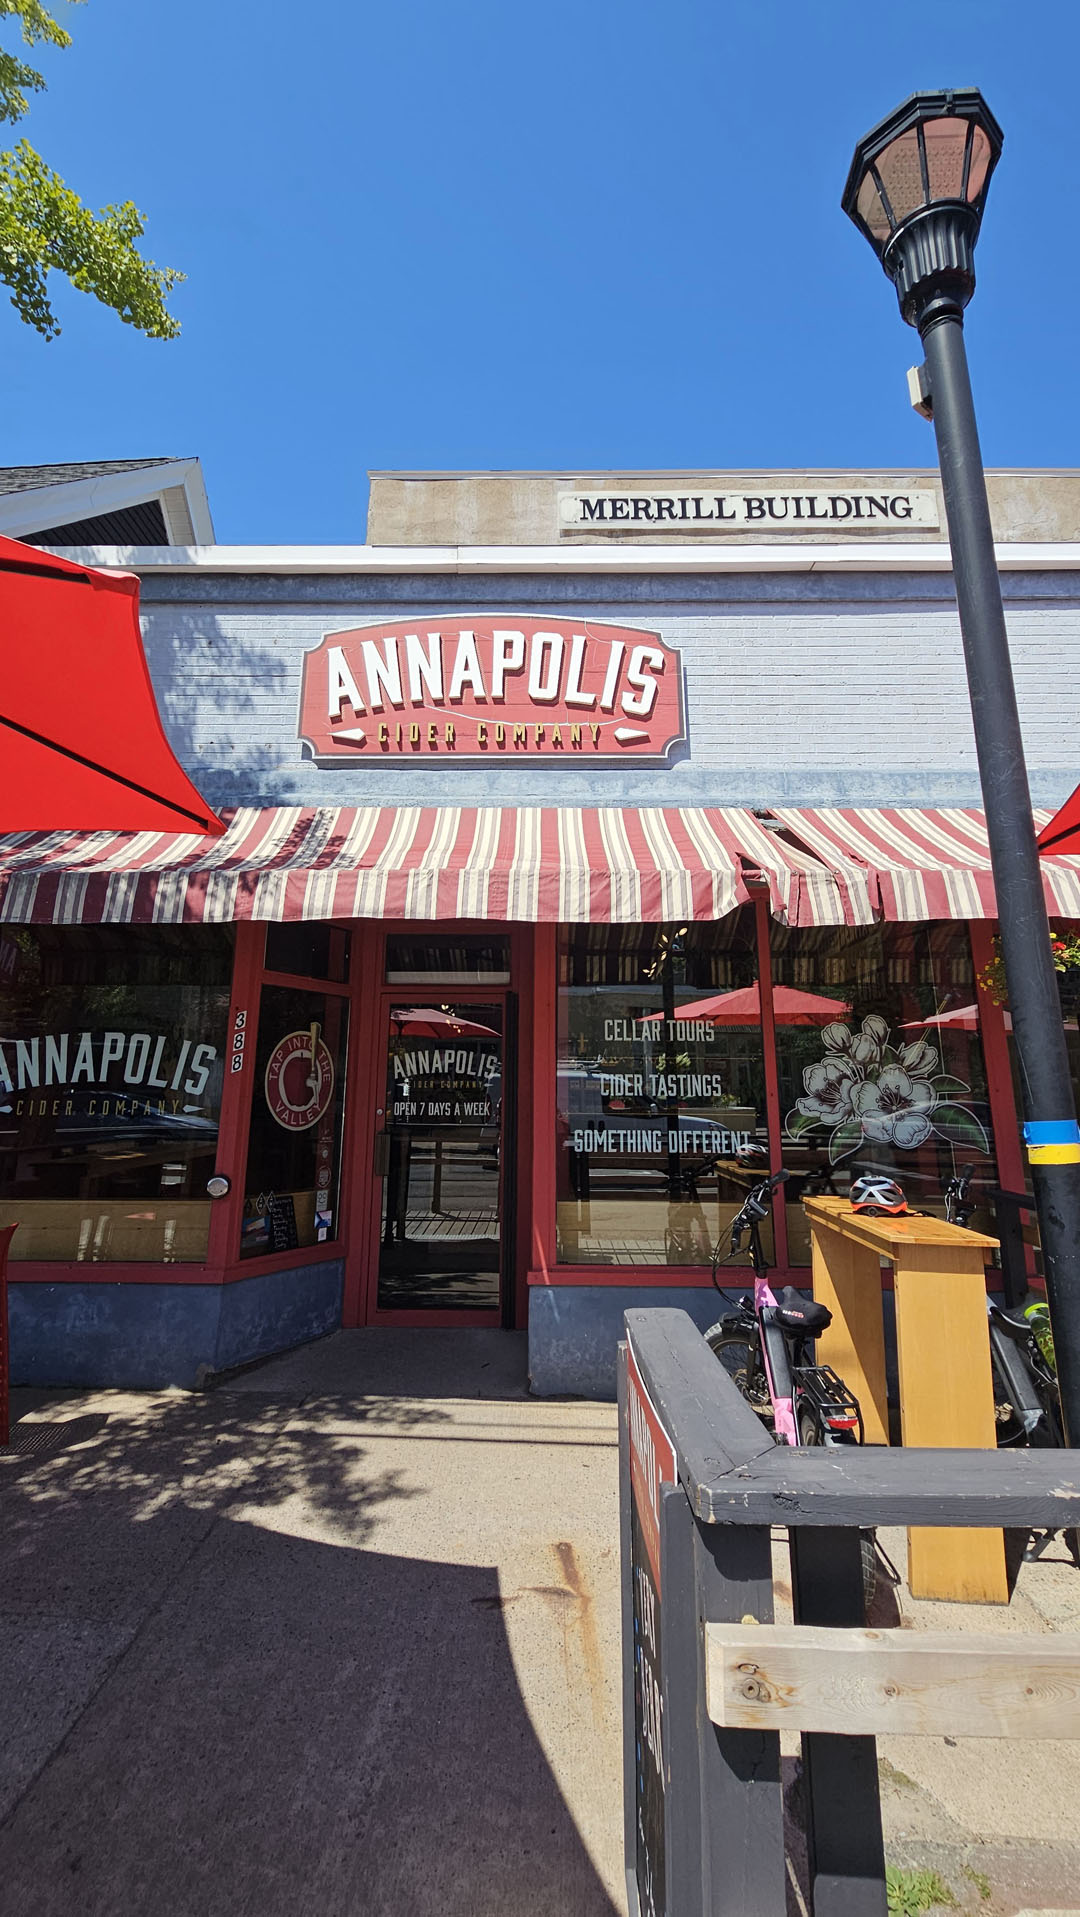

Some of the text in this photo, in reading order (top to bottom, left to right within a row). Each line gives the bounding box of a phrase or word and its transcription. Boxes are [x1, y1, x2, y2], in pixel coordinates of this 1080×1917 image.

[580, 496, 914, 520] MERRILL BUILDING
[328, 630, 665, 720] ANNAPOLIS
[378, 722, 602, 744] CIDER COMPANY
[604, 1019, 715, 1042] CELLAR TOURS
[269, 1051, 284, 1081] TAP
[318, 1052, 331, 1083] THE
[394, 1050, 498, 1079] ANNAPOLIS
[407, 1081, 483, 1089] IDER COMPANY
[600, 1074, 722, 1097] CIDER TASTINGS
[16, 1100, 180, 1116] CIDER COMPANY
[275, 1101, 321, 1125] VALLEY
[394, 1102, 490, 1116] OPEN 7 DAYS A WEEK
[574, 1129, 751, 1154] SOMETHING DIFFERENT
